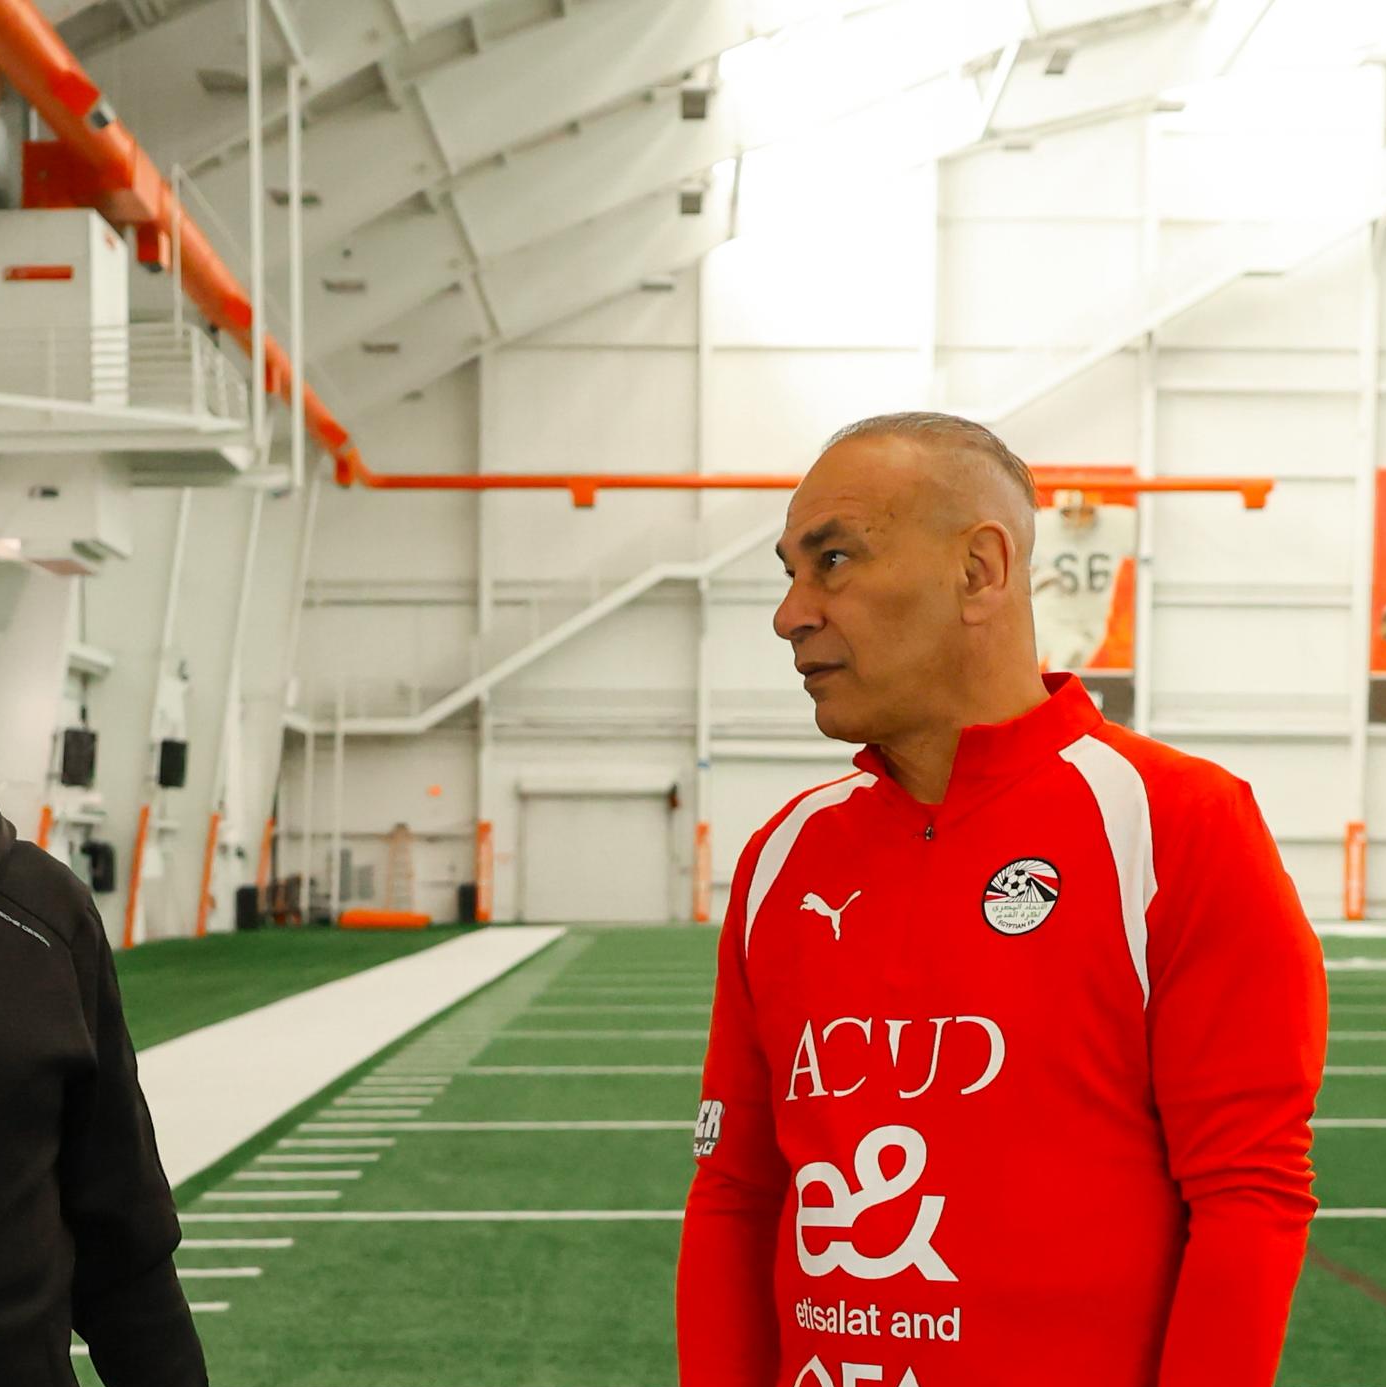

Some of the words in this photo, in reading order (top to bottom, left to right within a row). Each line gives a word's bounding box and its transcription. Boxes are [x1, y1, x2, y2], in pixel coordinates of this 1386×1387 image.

[785, 1015, 1006, 1101] ACUD
[795, 1297, 882, 1337] etisalat
[890, 1307, 962, 1343] and
